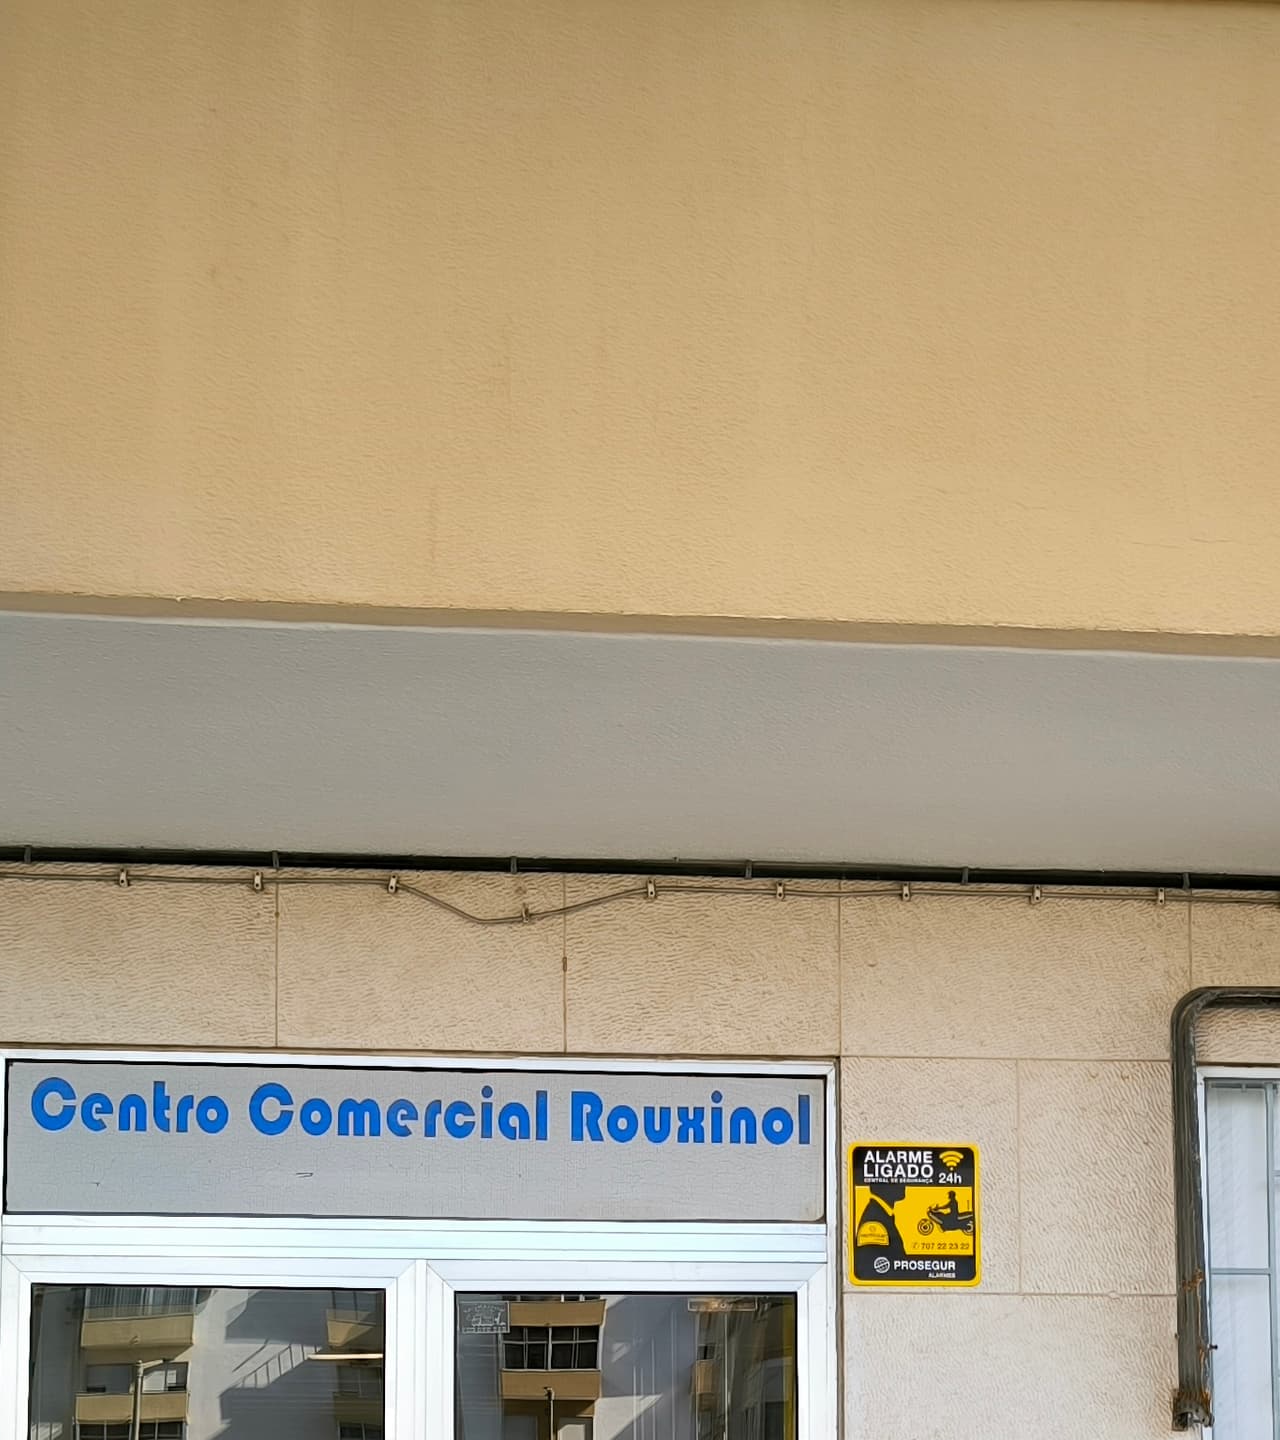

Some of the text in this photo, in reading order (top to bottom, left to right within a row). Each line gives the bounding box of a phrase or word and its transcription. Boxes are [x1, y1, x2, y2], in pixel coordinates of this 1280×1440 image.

[30, 1076, 811, 1146] Centro Comercial Rouxinol
[863, 1150, 933, 1164] ALARME
[863, 1164, 934, 1178] LIGADO
[938, 1172, 962, 1184] 24h
[893, 1260, 956, 1271] PROSEGUR
